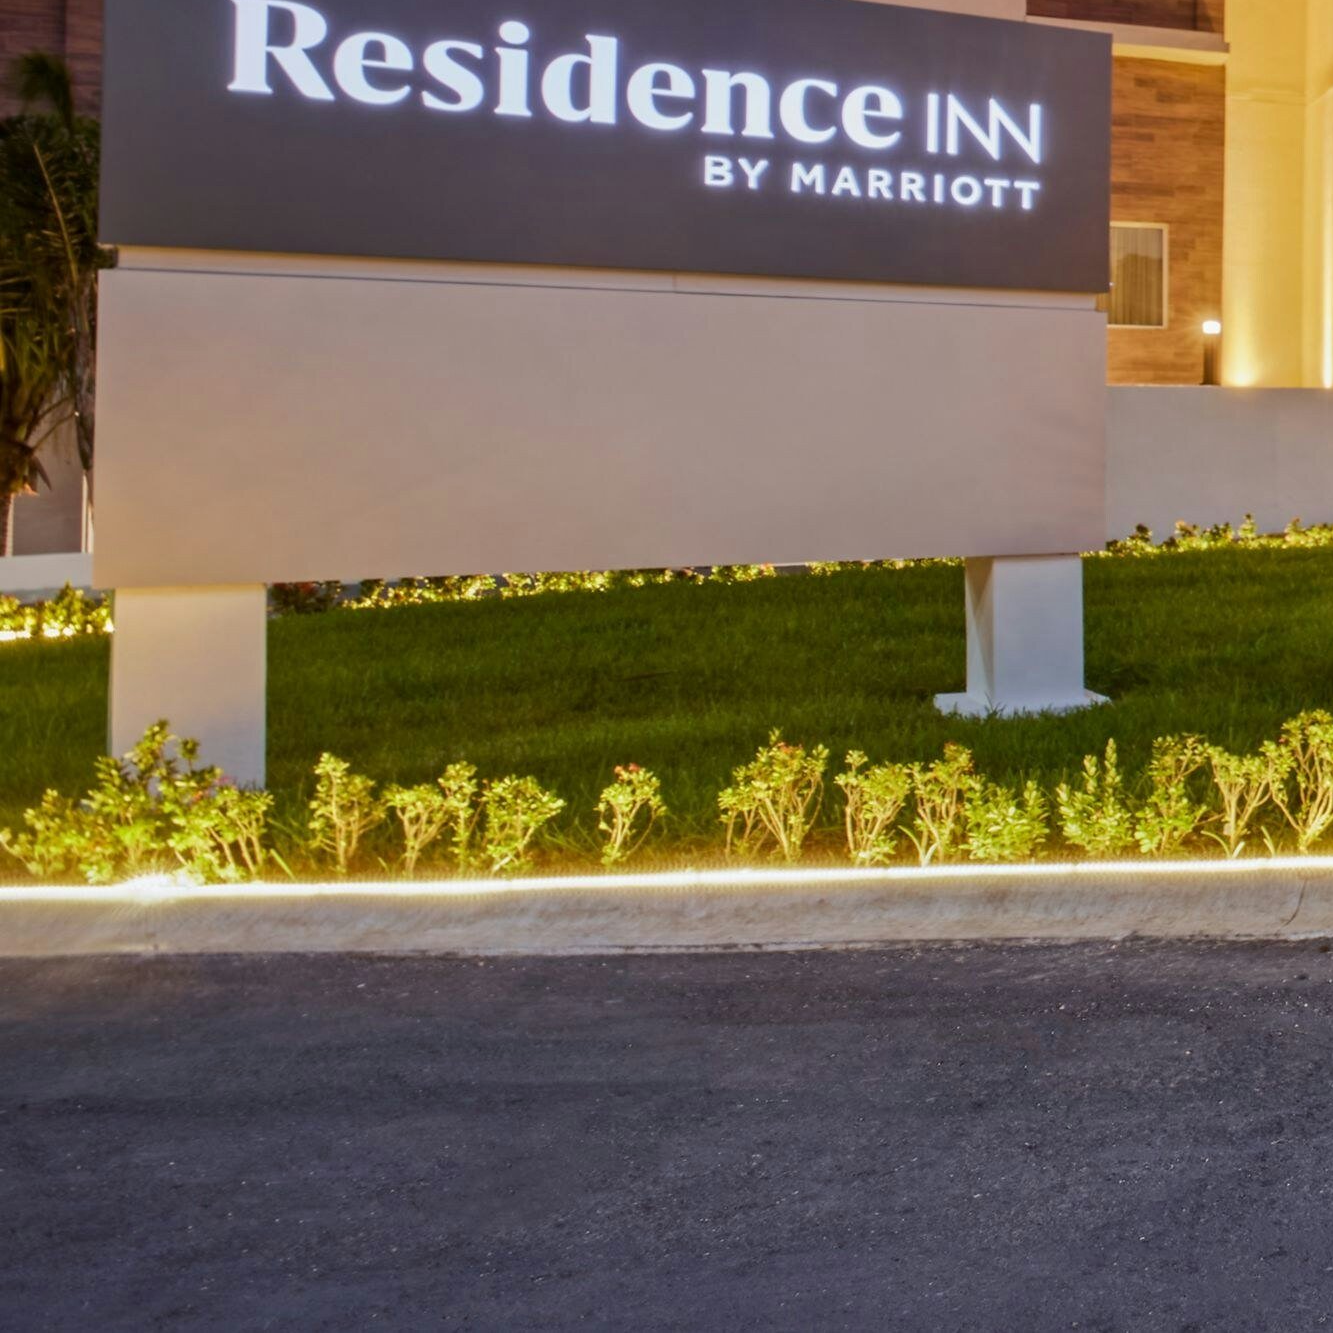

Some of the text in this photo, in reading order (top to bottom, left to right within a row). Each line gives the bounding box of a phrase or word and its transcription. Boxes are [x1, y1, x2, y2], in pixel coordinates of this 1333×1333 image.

[926, 92, 1042, 164] INN
[704, 155, 1041, 210] BY MARRIOTT
